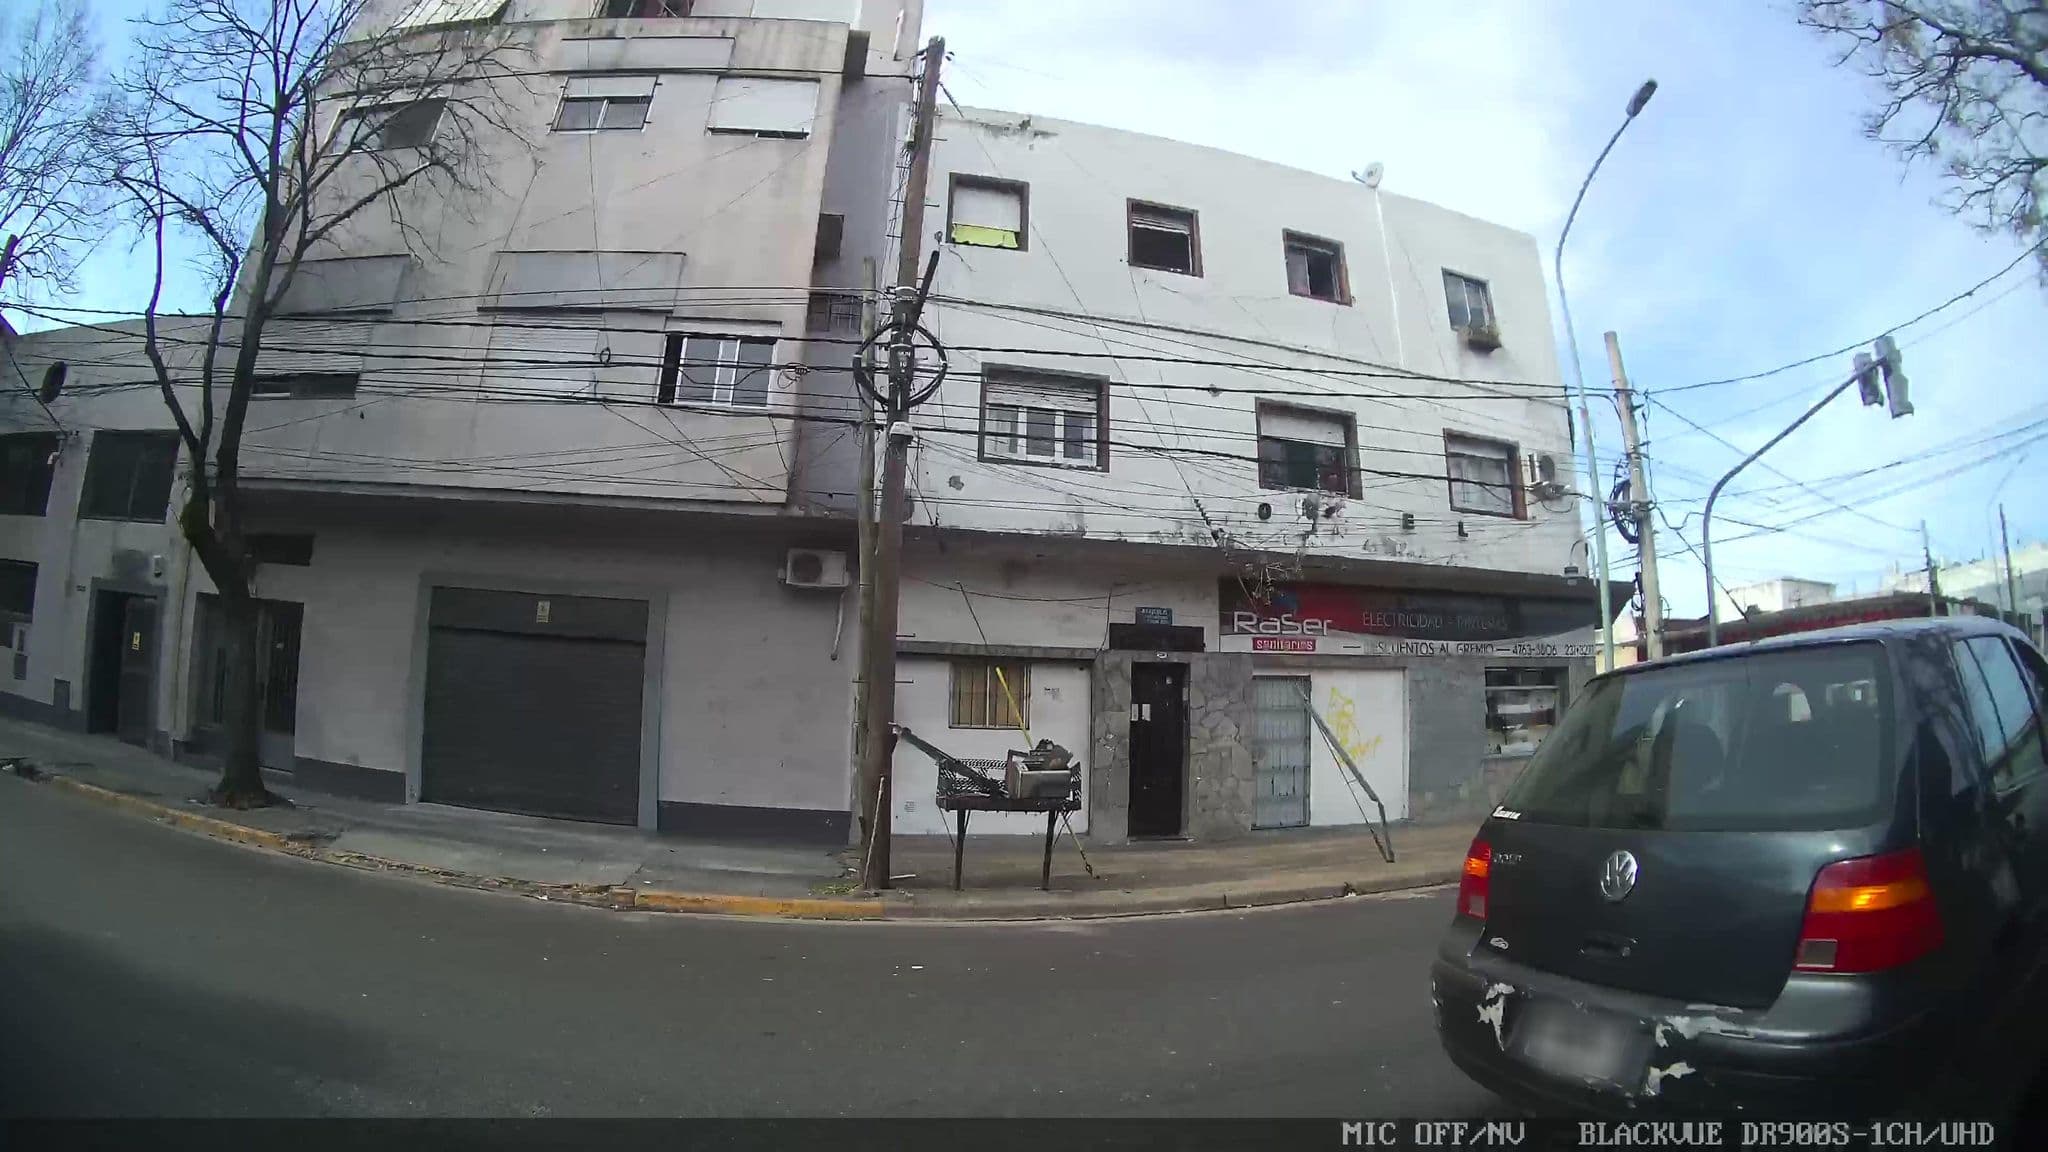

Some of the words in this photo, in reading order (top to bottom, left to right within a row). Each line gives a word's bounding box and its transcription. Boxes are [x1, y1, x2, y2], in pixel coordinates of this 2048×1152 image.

[1233, 611, 1333, 636] RaSer
[1256, 639, 1314, 650] sanitarios
[1439, 643, 1451, 655] AL
[1456, 643, 1494, 655] GREMIO
